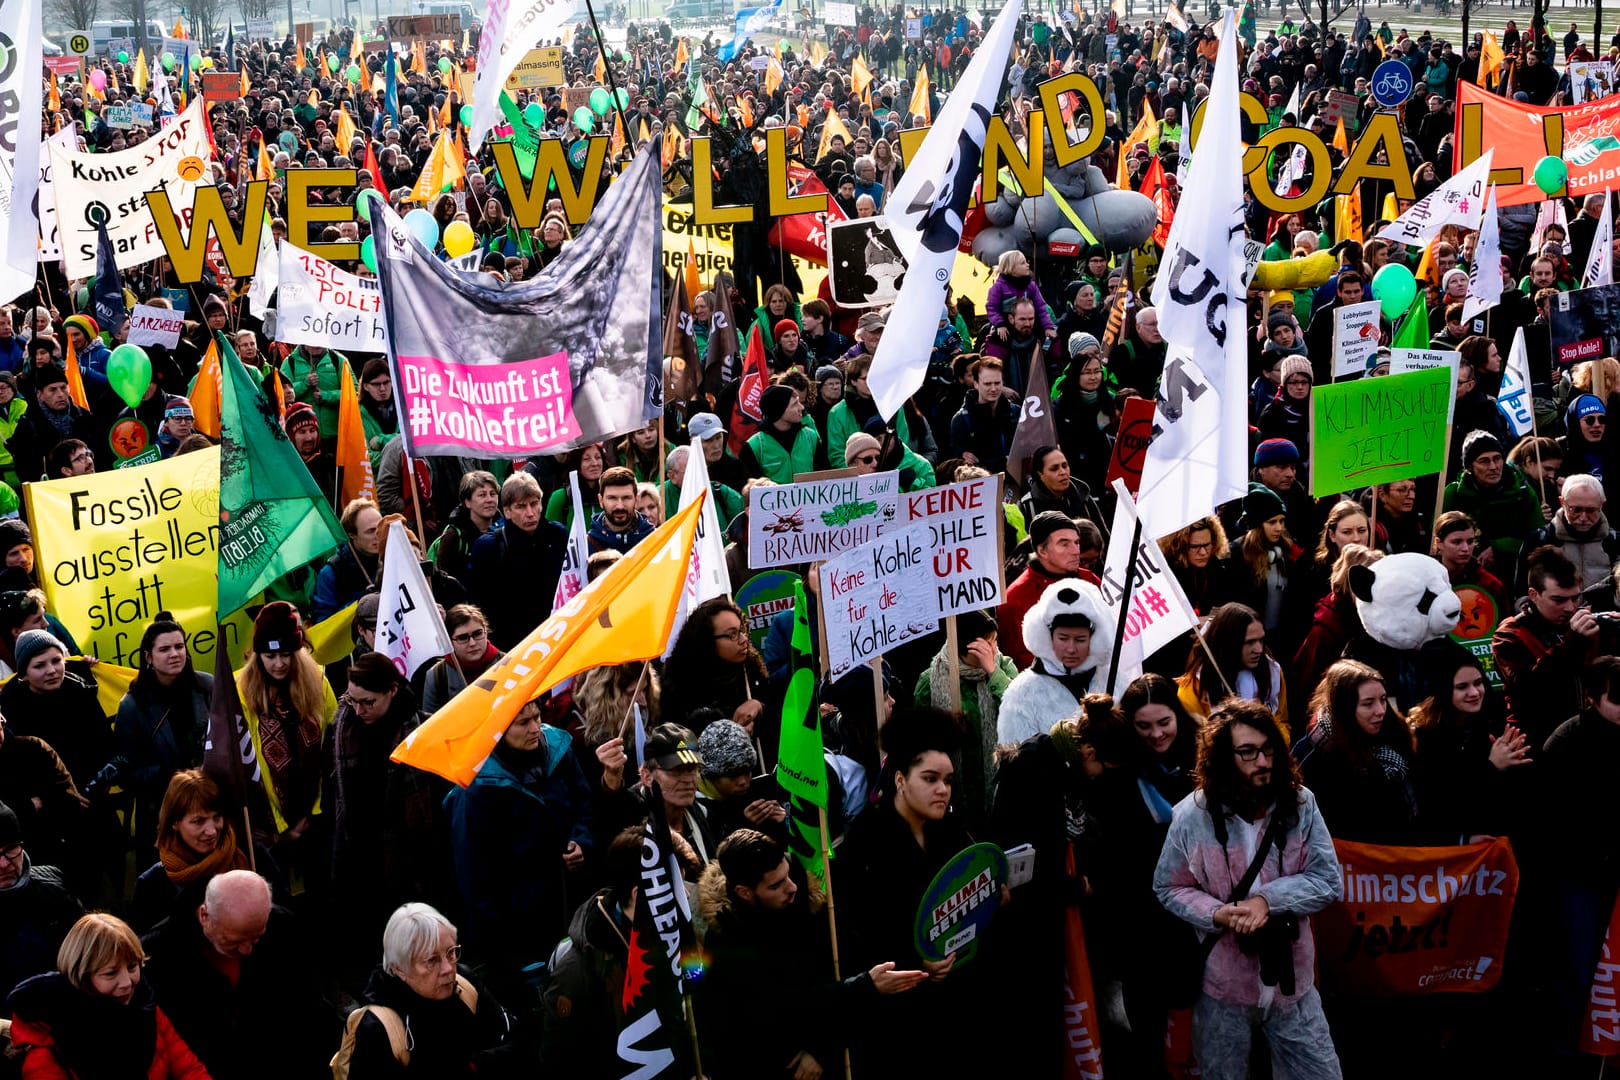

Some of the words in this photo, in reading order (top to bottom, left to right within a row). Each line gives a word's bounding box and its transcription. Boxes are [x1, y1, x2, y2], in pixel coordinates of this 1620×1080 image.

[434, 17, 460, 35] WEG
[514, 60, 560, 72] almassing
[108, 107, 132, 117] KLIMA
[71, 159, 138, 182] Kohle
[144, 167, 360, 285] WE
[489, 126, 829, 230] WLL
[80, 234, 138, 261] Slar
[300, 311, 361, 338] sofort
[1407, 352, 1420, 360] Das
[1422, 353, 1443, 361] Klima
[1561, 346, 1577, 360] Stop
[1577, 340, 1600, 355] Kohle!
[404, 364, 442, 396] Die
[444, 364, 528, 405] Zukunft
[533, 365, 562, 398] ist
[409, 395, 569, 447] #kohlefrei!
[1322, 382, 1450, 433] KLIMASCHUTZ
[1580, 405, 1600, 415] NABU
[69, 477, 183, 532] Fossile
[760, 479, 864, 511] GRÜNKOHL
[908, 481, 985, 521] KEINE
[53, 518, 222, 587] ausstellen
[830, 567, 865, 601] Keine
[873, 535, 922, 579] Kohle
[932, 546, 973, 578] ÜR
[87, 573, 164, 632] statt
[750, 598, 796, 617] KLIMA
[846, 597, 868, 623] für
[878, 584, 897, 611] die
[937, 576, 998, 612] MAND
[849, 614, 898, 662] Kohle
[935, 872, 990, 922] KLIMA
[1338, 863, 1507, 904] limaschutz
[930, 880, 997, 942] RETTEN!
[1343, 906, 1455, 964] jetzt!
